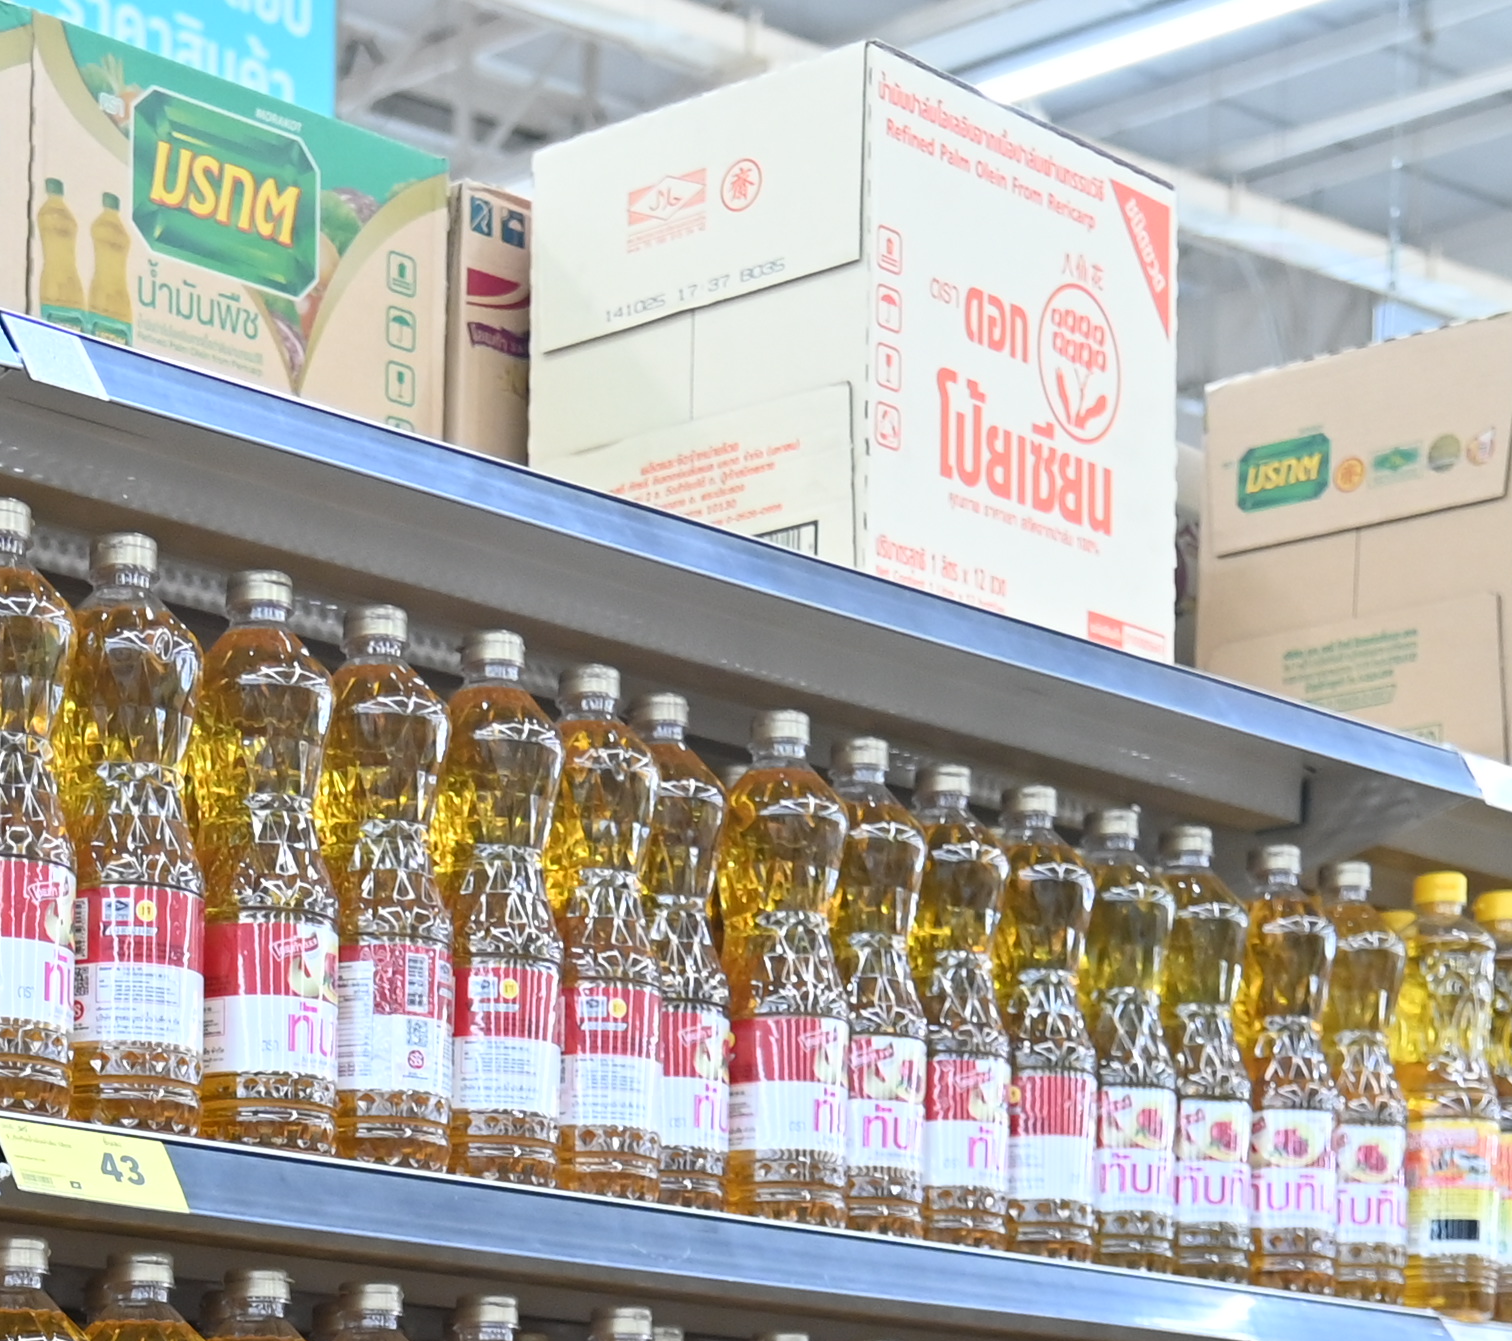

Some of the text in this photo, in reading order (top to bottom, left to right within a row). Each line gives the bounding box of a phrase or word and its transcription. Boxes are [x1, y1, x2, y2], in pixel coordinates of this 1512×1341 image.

[149, 141, 302, 251] มรกต
[886, 118, 936, 155] Refined
[940, 143, 971, 172] Palm
[975, 160, 1008, 190] Olein
[1013, 177, 1043, 204] From
[137, 259, 261, 341] น้ำมันพืช
[930, 277, 1029, 364] ตรา ดอก
[1245, 452, 1323, 494] มรกต
[100, 1152, 146, 1187] 43
